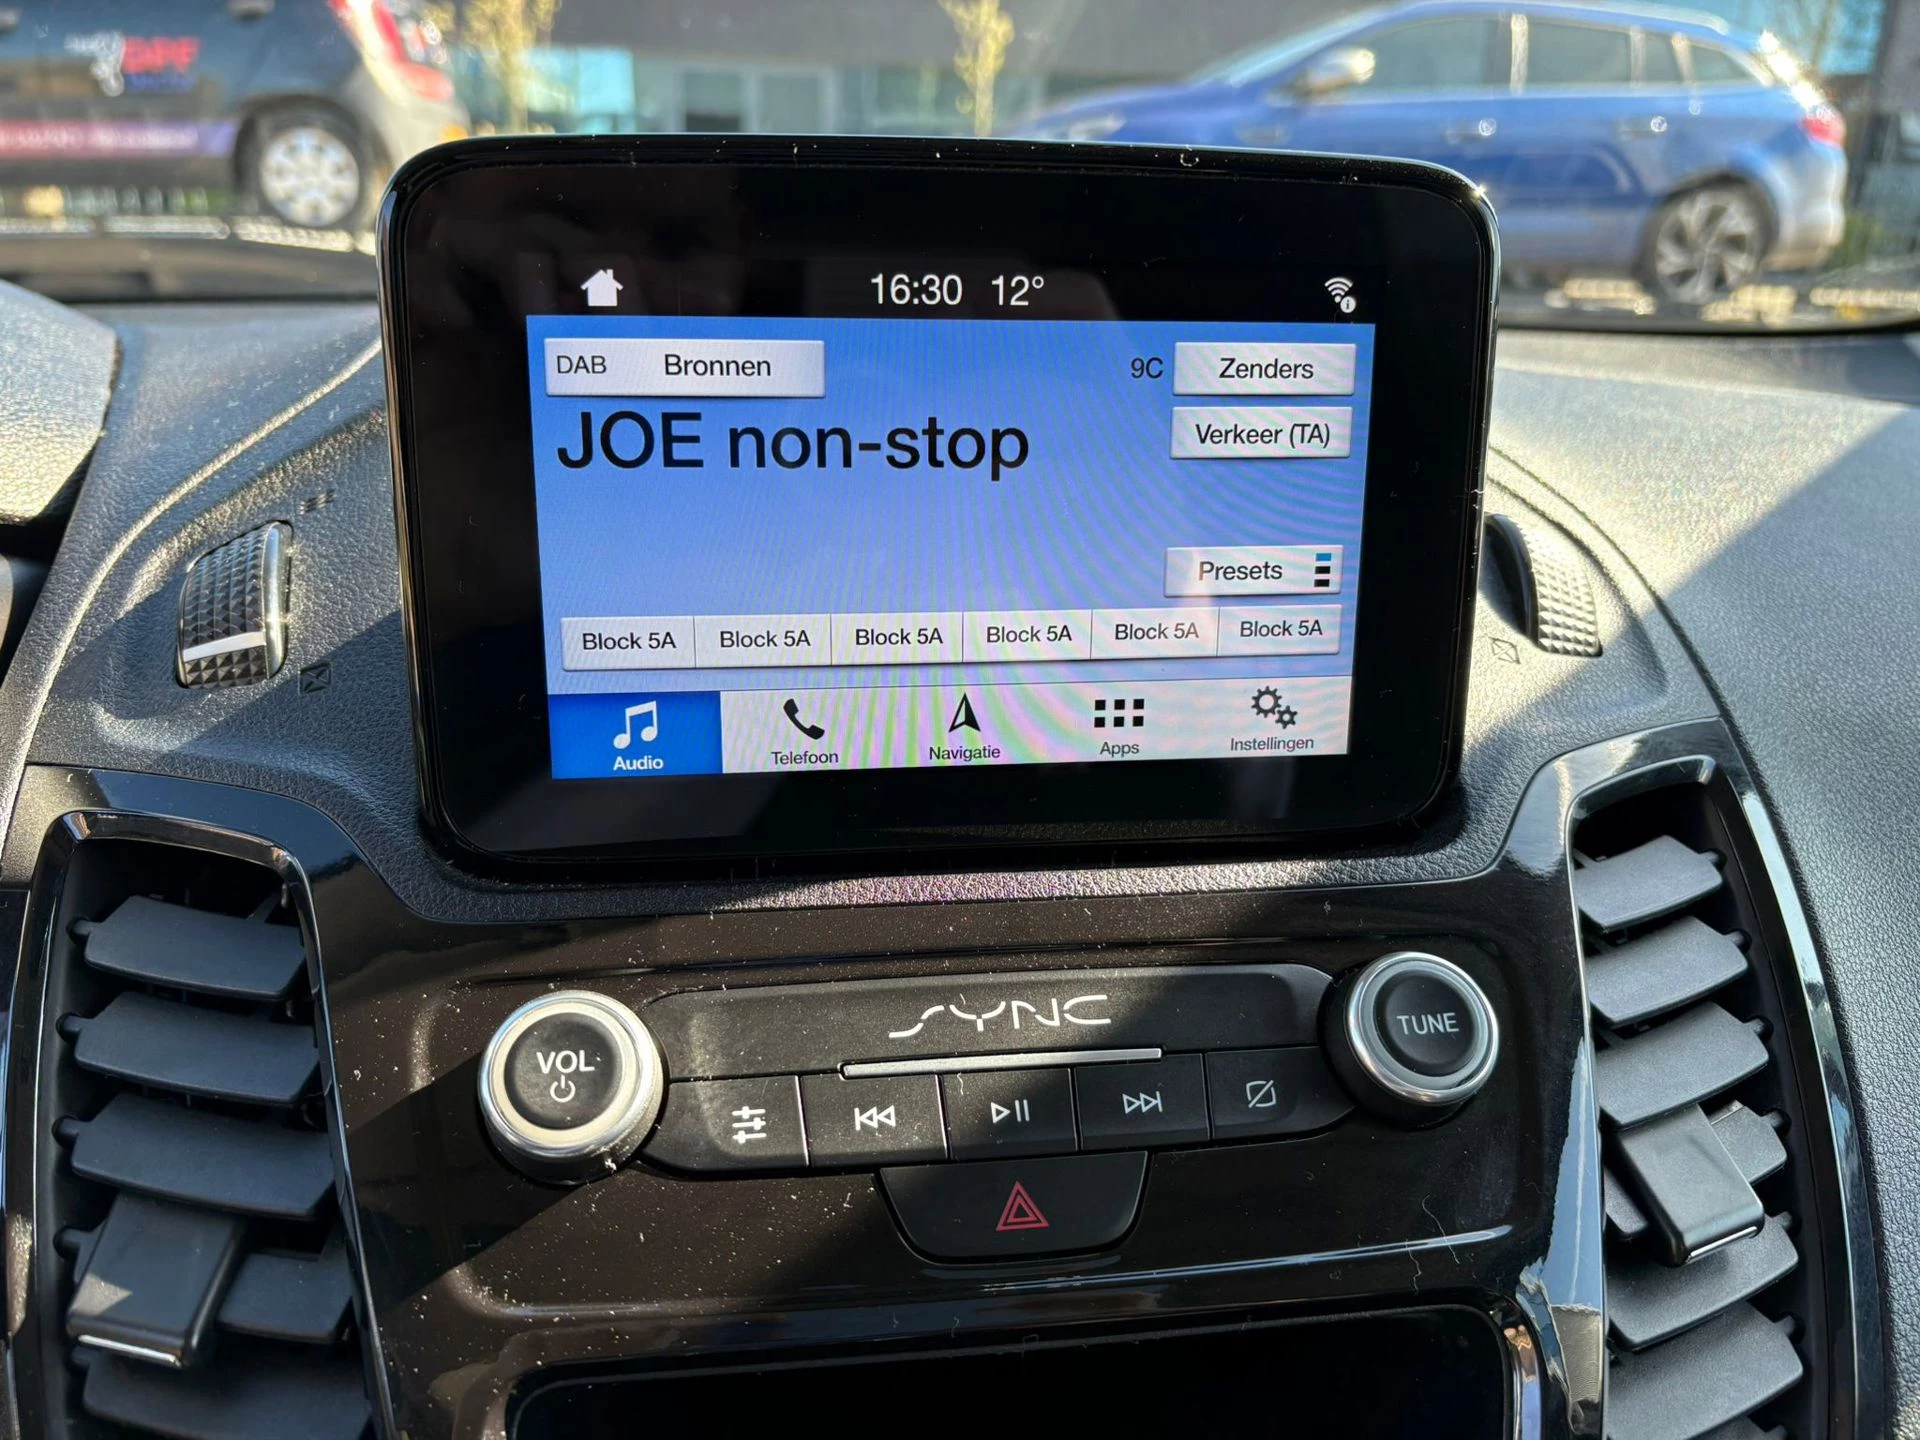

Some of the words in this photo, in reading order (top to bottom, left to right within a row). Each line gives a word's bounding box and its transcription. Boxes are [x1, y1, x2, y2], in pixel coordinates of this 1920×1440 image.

[871, 273, 963, 306] 16:30
[991, 275, 1044, 306] 12°
[556, 355, 607, 374] DAB
[664, 353, 771, 377] Bronnen
[1131, 356, 1164, 379] 9C
[1219, 357, 1314, 380] Zenders
[1195, 423, 1284, 445] Verkeer
[1289, 423, 1330, 449] (TA)
[557, 410, 704, 469] JOE
[729, 416, 1029, 482] non-stop
[1200, 561, 1283, 581] Presets
[855, 628, 911, 646] Block
[916, 627, 944, 645] 5A
[986, 625, 1042, 643] Block
[1046, 624, 1073, 642] 5A
[1115, 623, 1169, 641] Block
[1172, 622, 1199, 640] 5A
[1240, 619, 1293, 638] Block
[1297, 619, 1323, 637] 5A
[582, 632, 642, 650] Block
[647, 631, 677, 650] 5A
[720, 630, 778, 648] Block
[783, 629, 811, 647] 5A
[929, 745, 1001, 761] Navigatie
[1099, 741, 1140, 757] Apps
[1230, 737, 1315, 754] Instellingen
[613, 755, 664, 771] Audio
[770, 750, 839, 765] Telefoon
[888, 993, 1112, 1039] SYNC
[1396, 1012, 1459, 1035] TUNE
[536, 1050, 595, 1073] VOL
